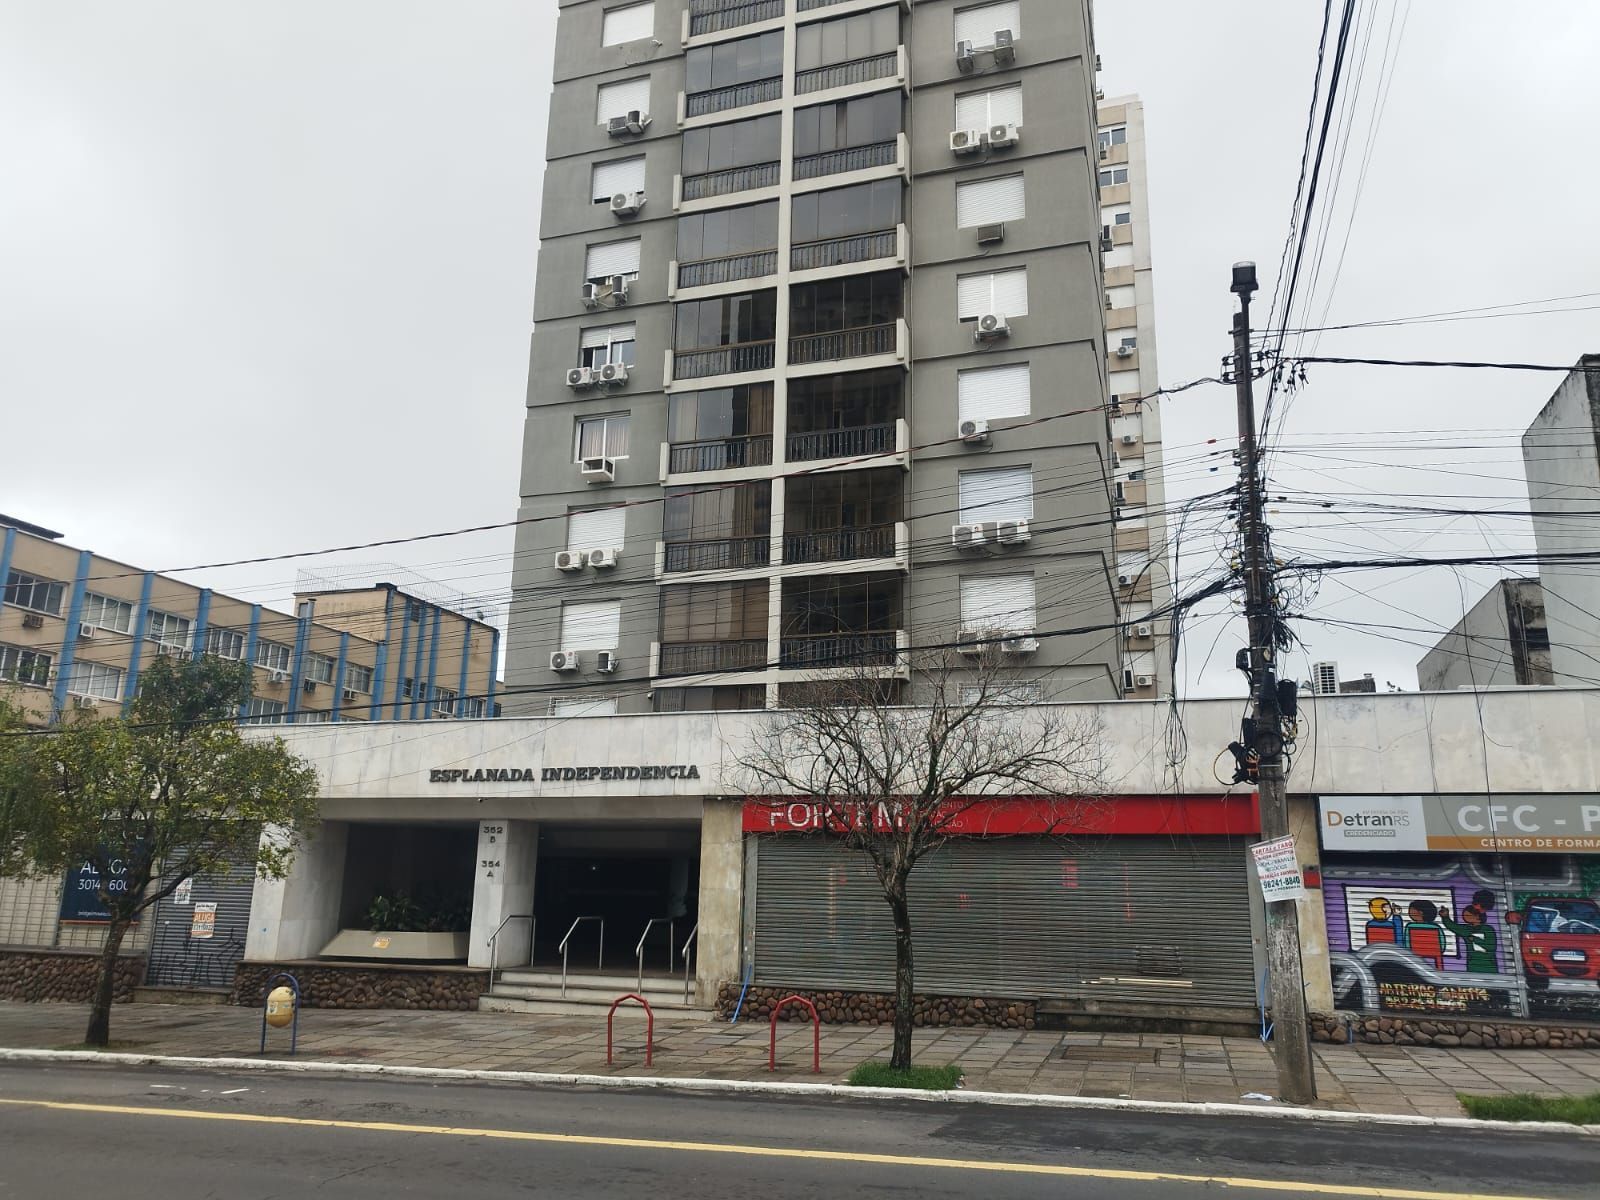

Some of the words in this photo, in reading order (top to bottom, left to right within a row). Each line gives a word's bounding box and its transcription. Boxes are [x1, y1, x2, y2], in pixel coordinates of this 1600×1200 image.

[429, 769, 535, 782] ESPLANADA
[540, 765, 701, 781] INDEPENDENCIA
[1457, 804, 1540, 833] CFC
[483, 826, 503, 834] 352
[1480, 838, 1532, 848] CENTRO
[1536, 838, 1553, 848] DE
[481, 860, 500, 868] 354
